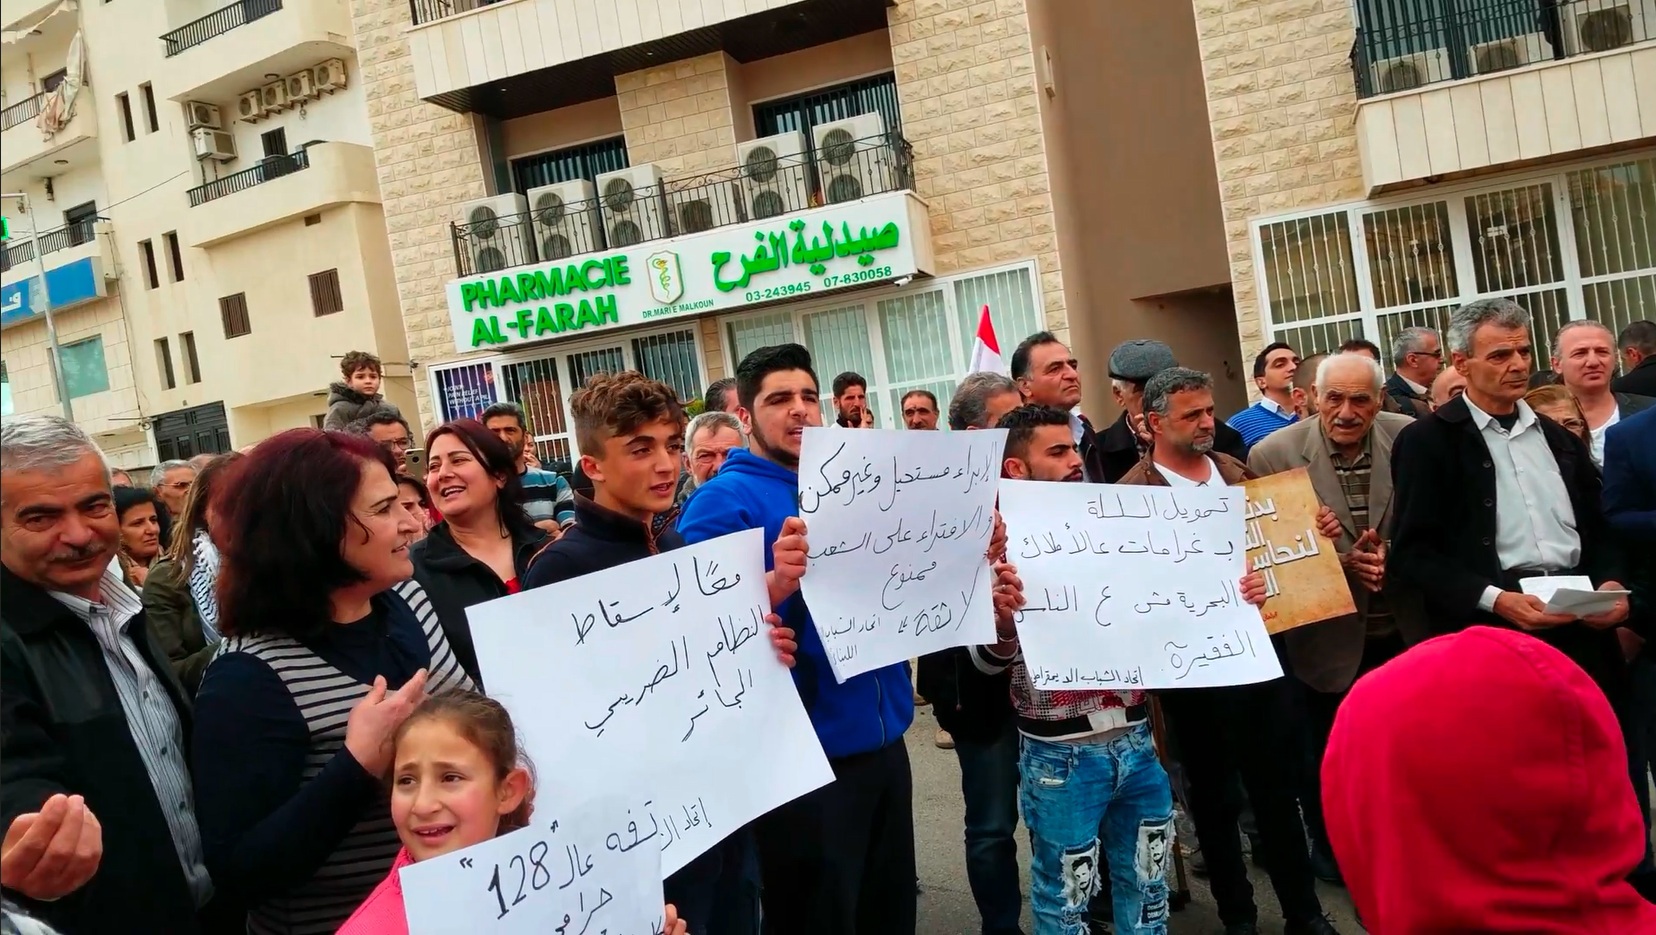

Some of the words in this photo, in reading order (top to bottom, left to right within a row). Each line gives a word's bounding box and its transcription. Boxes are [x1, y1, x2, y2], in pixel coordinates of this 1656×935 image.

[711, 229, 790, 292] الفرح
[791, 216, 899, 276] صيدلية
[461, 254, 631, 312] PHARMACIE
[679, 299, 714, 312] MALKOUN
[745, 281, 811, 302] 03-243945
[823, 266, 893, 288] 07-830058
[471, 294, 618, 347] AL-FARAH
[799, 442, 851, 513] ممكن
[879, 456, 950, 512] مستحيل
[1163, 493, 1229, 523] تمويل
[806, 531, 871, 567] الشعب
[873, 518, 912, 555] على
[1118, 529, 1204, 563] غرامات
[1252, 528, 1321, 572] لنحاس
[882, 561, 937, 611] ممنوع
[955, 566, 980, 631] لا
[1014, 585, 1078, 623] الناس
[1134, 590, 1170, 614] مش
[1178, 579, 1240, 616] البحرية
[707, 604, 764, 688] النظام
[1164, 630, 1256, 680] الفقيرة
[585, 635, 690, 737] الضريبي
[1080, 669, 1121, 686] الشباب
[682, 668, 753, 743] الجائر
